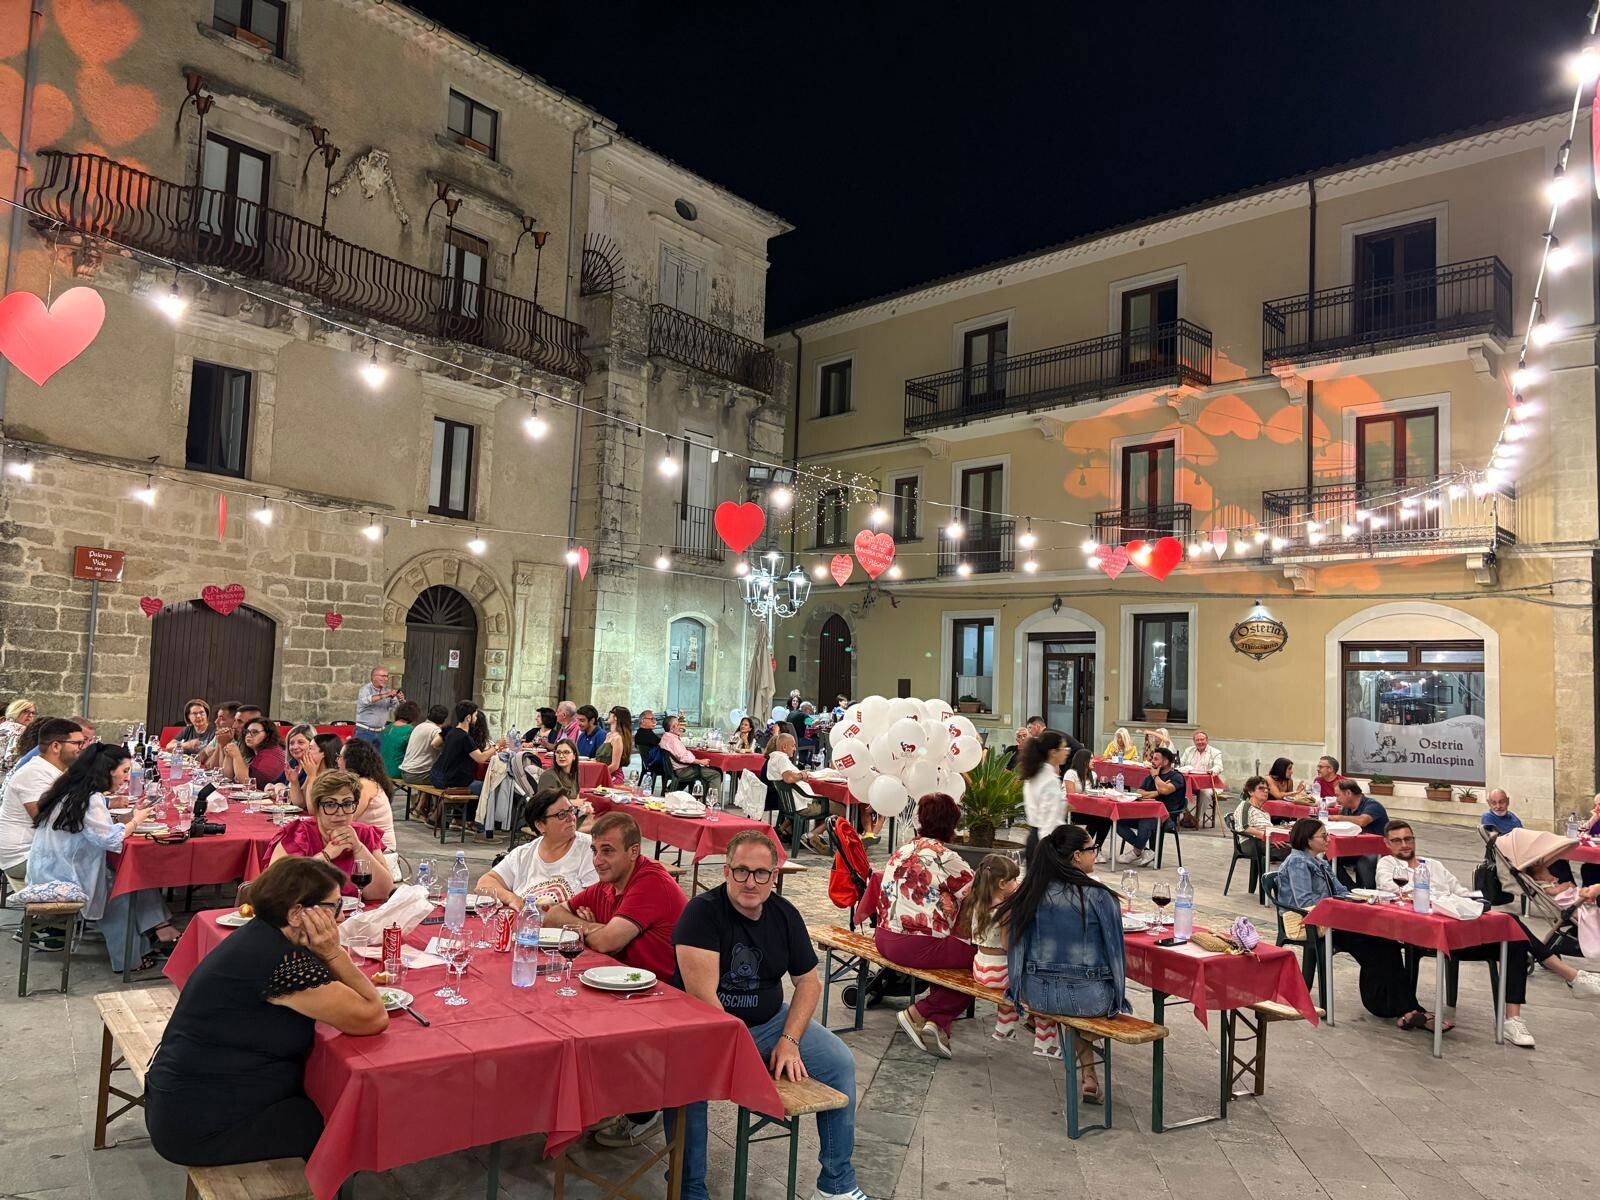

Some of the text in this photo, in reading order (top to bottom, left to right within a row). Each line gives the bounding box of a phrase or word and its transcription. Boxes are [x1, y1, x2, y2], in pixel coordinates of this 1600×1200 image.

[88, 550, 113, 560] Palazzo
[1237, 624, 1282, 637] Osteria
[1419, 737, 1464, 751] Osteria
[1409, 751, 1475, 768] Malaspina
[718, 992, 759, 1008] OSCHINO
